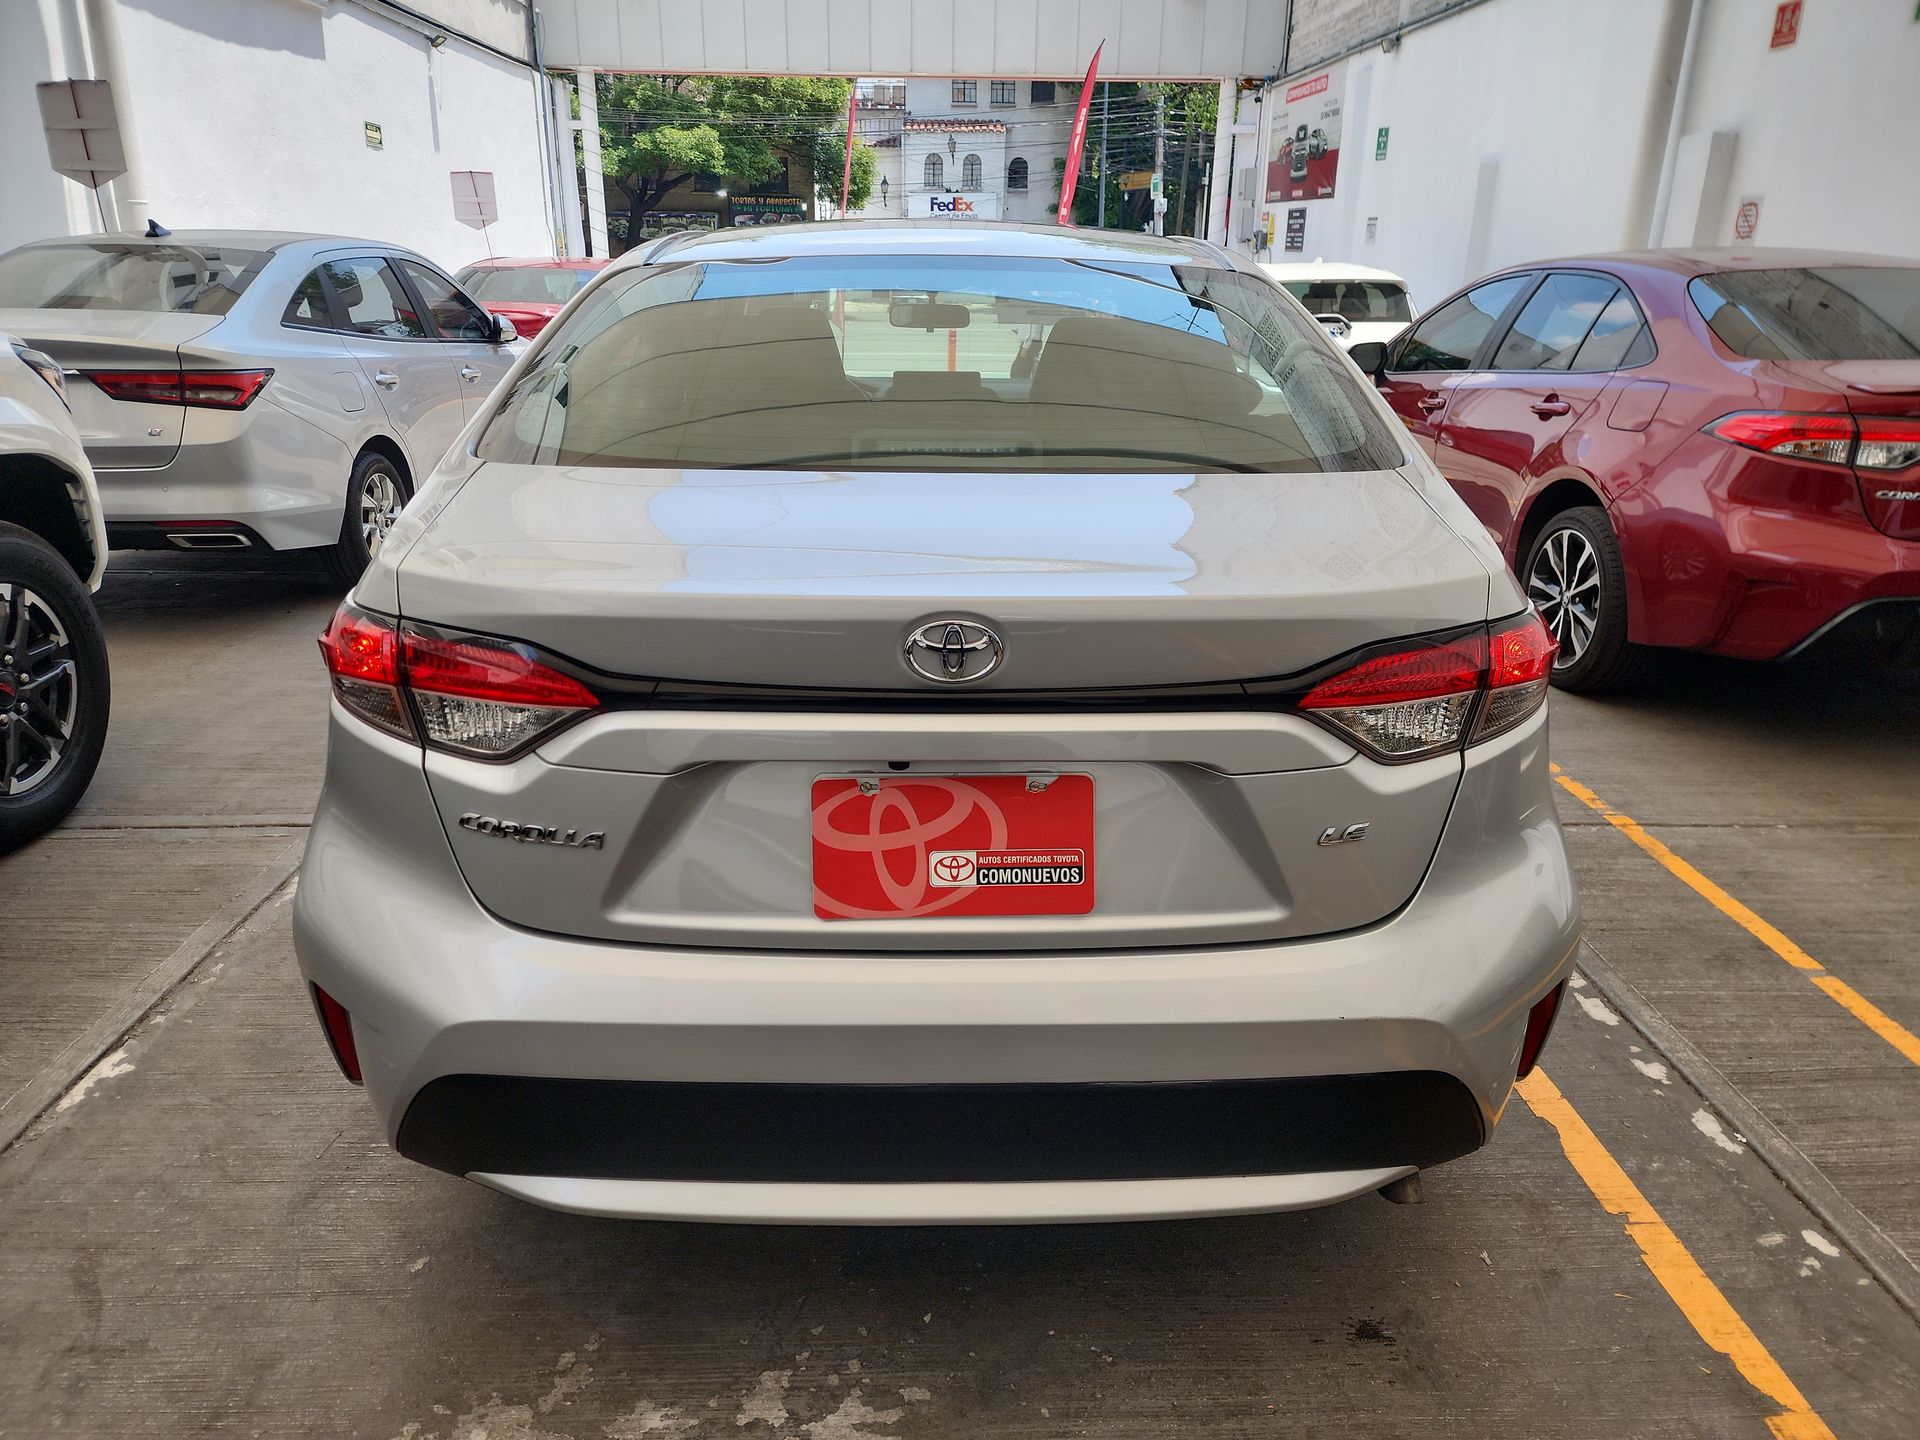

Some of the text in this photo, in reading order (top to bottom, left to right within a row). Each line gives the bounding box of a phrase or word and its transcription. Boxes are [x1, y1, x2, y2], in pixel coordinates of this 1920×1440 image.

[731, 196, 756, 205] TORTAS
[930, 196, 974, 211] FedEx
[148, 428, 163, 437] LT
[459, 812, 605, 850] COROLLA
[1318, 821, 1370, 846] LE
[978, 855, 1079, 864] AUTOS CERTIFICADOS TOYOTA
[979, 867, 1080, 884] COMONUEVOS
